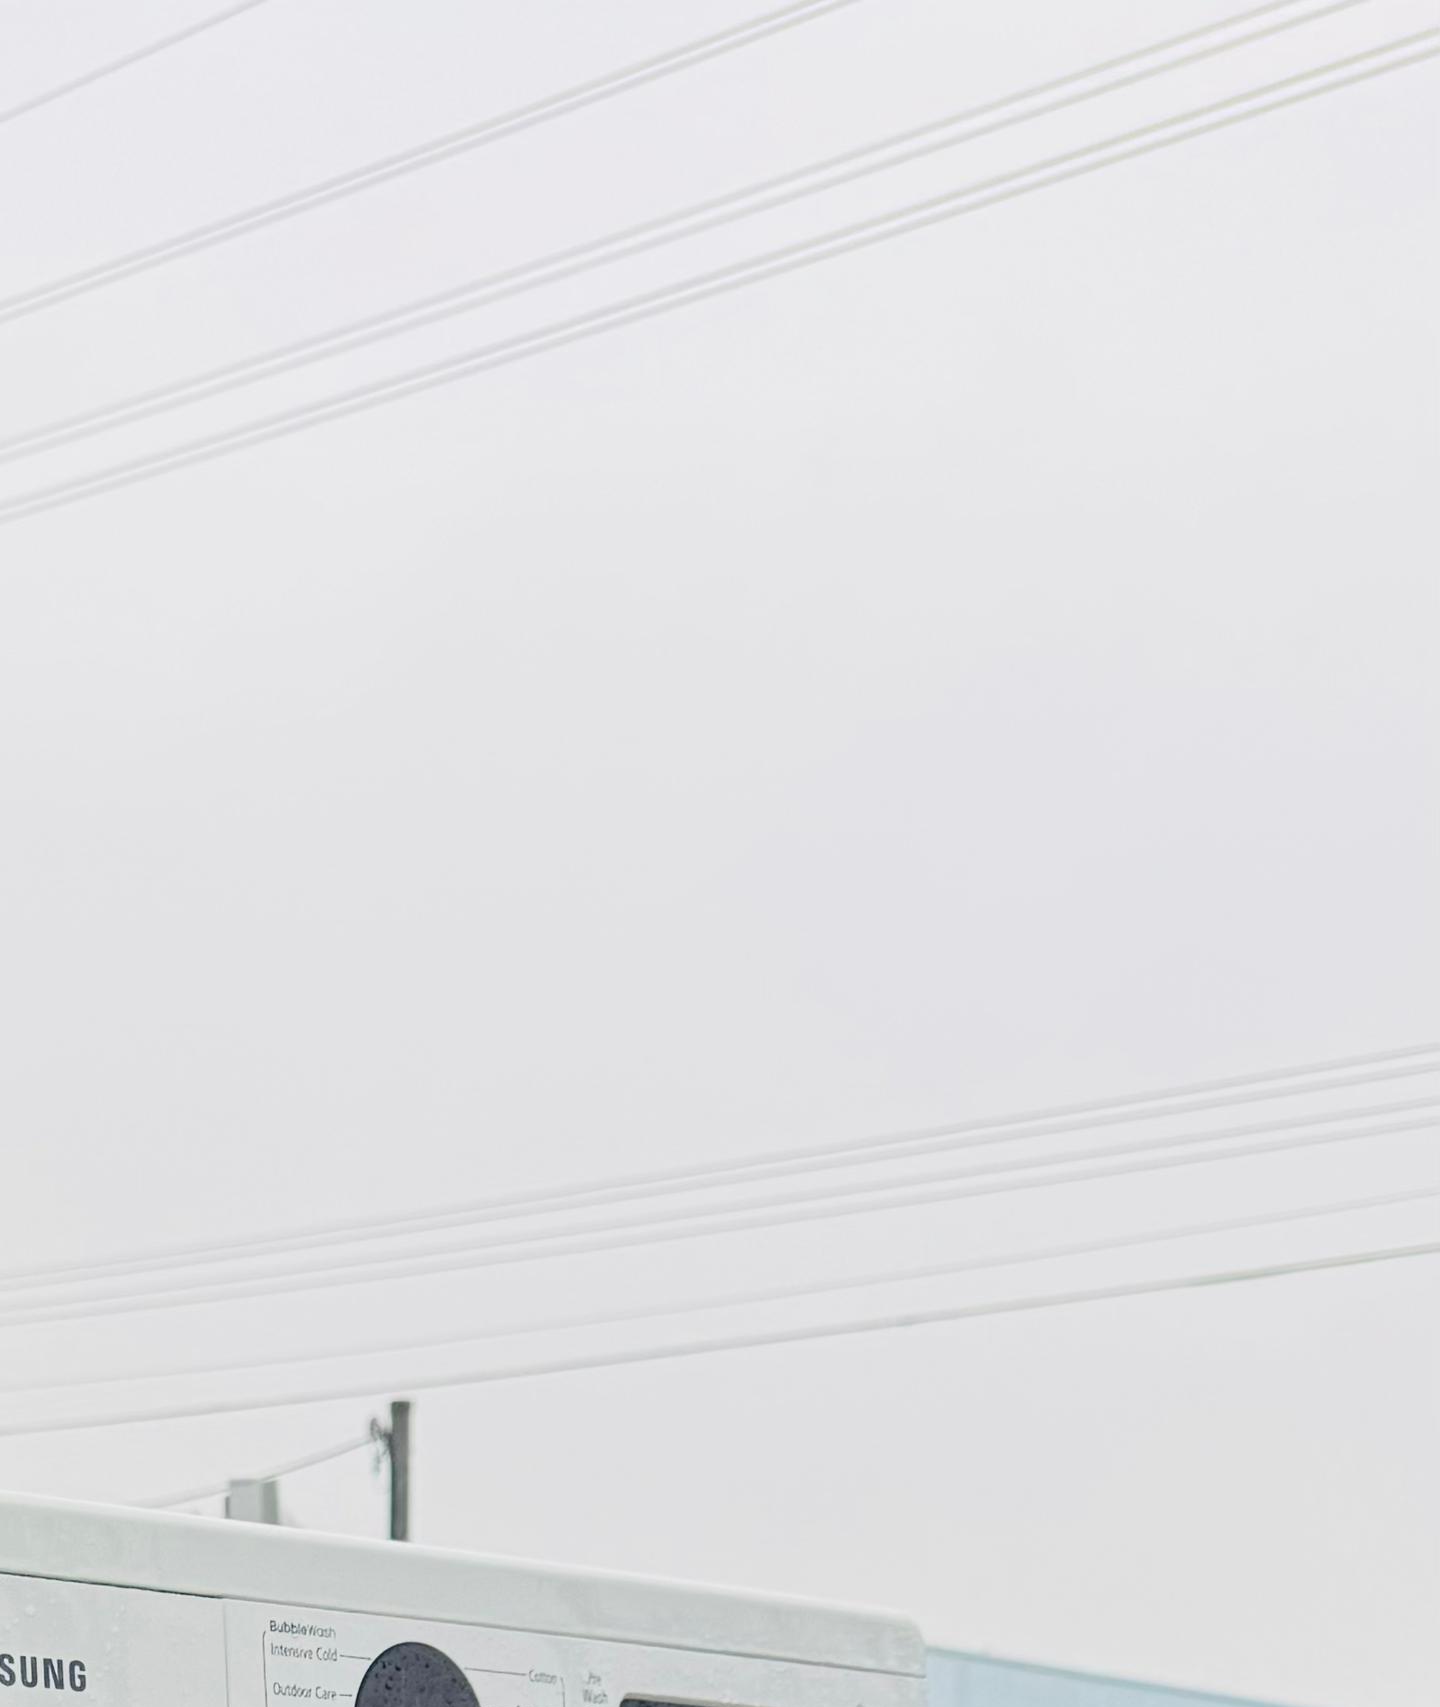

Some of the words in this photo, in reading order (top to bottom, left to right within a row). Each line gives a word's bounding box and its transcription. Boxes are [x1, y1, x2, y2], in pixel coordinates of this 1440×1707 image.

[270, 1643, 313, 1660] Intensive
[316, 1647, 338, 1661] Cold
[272, 1682, 312, 1699] Outdoor
[315, 1686, 337, 1700] Care
